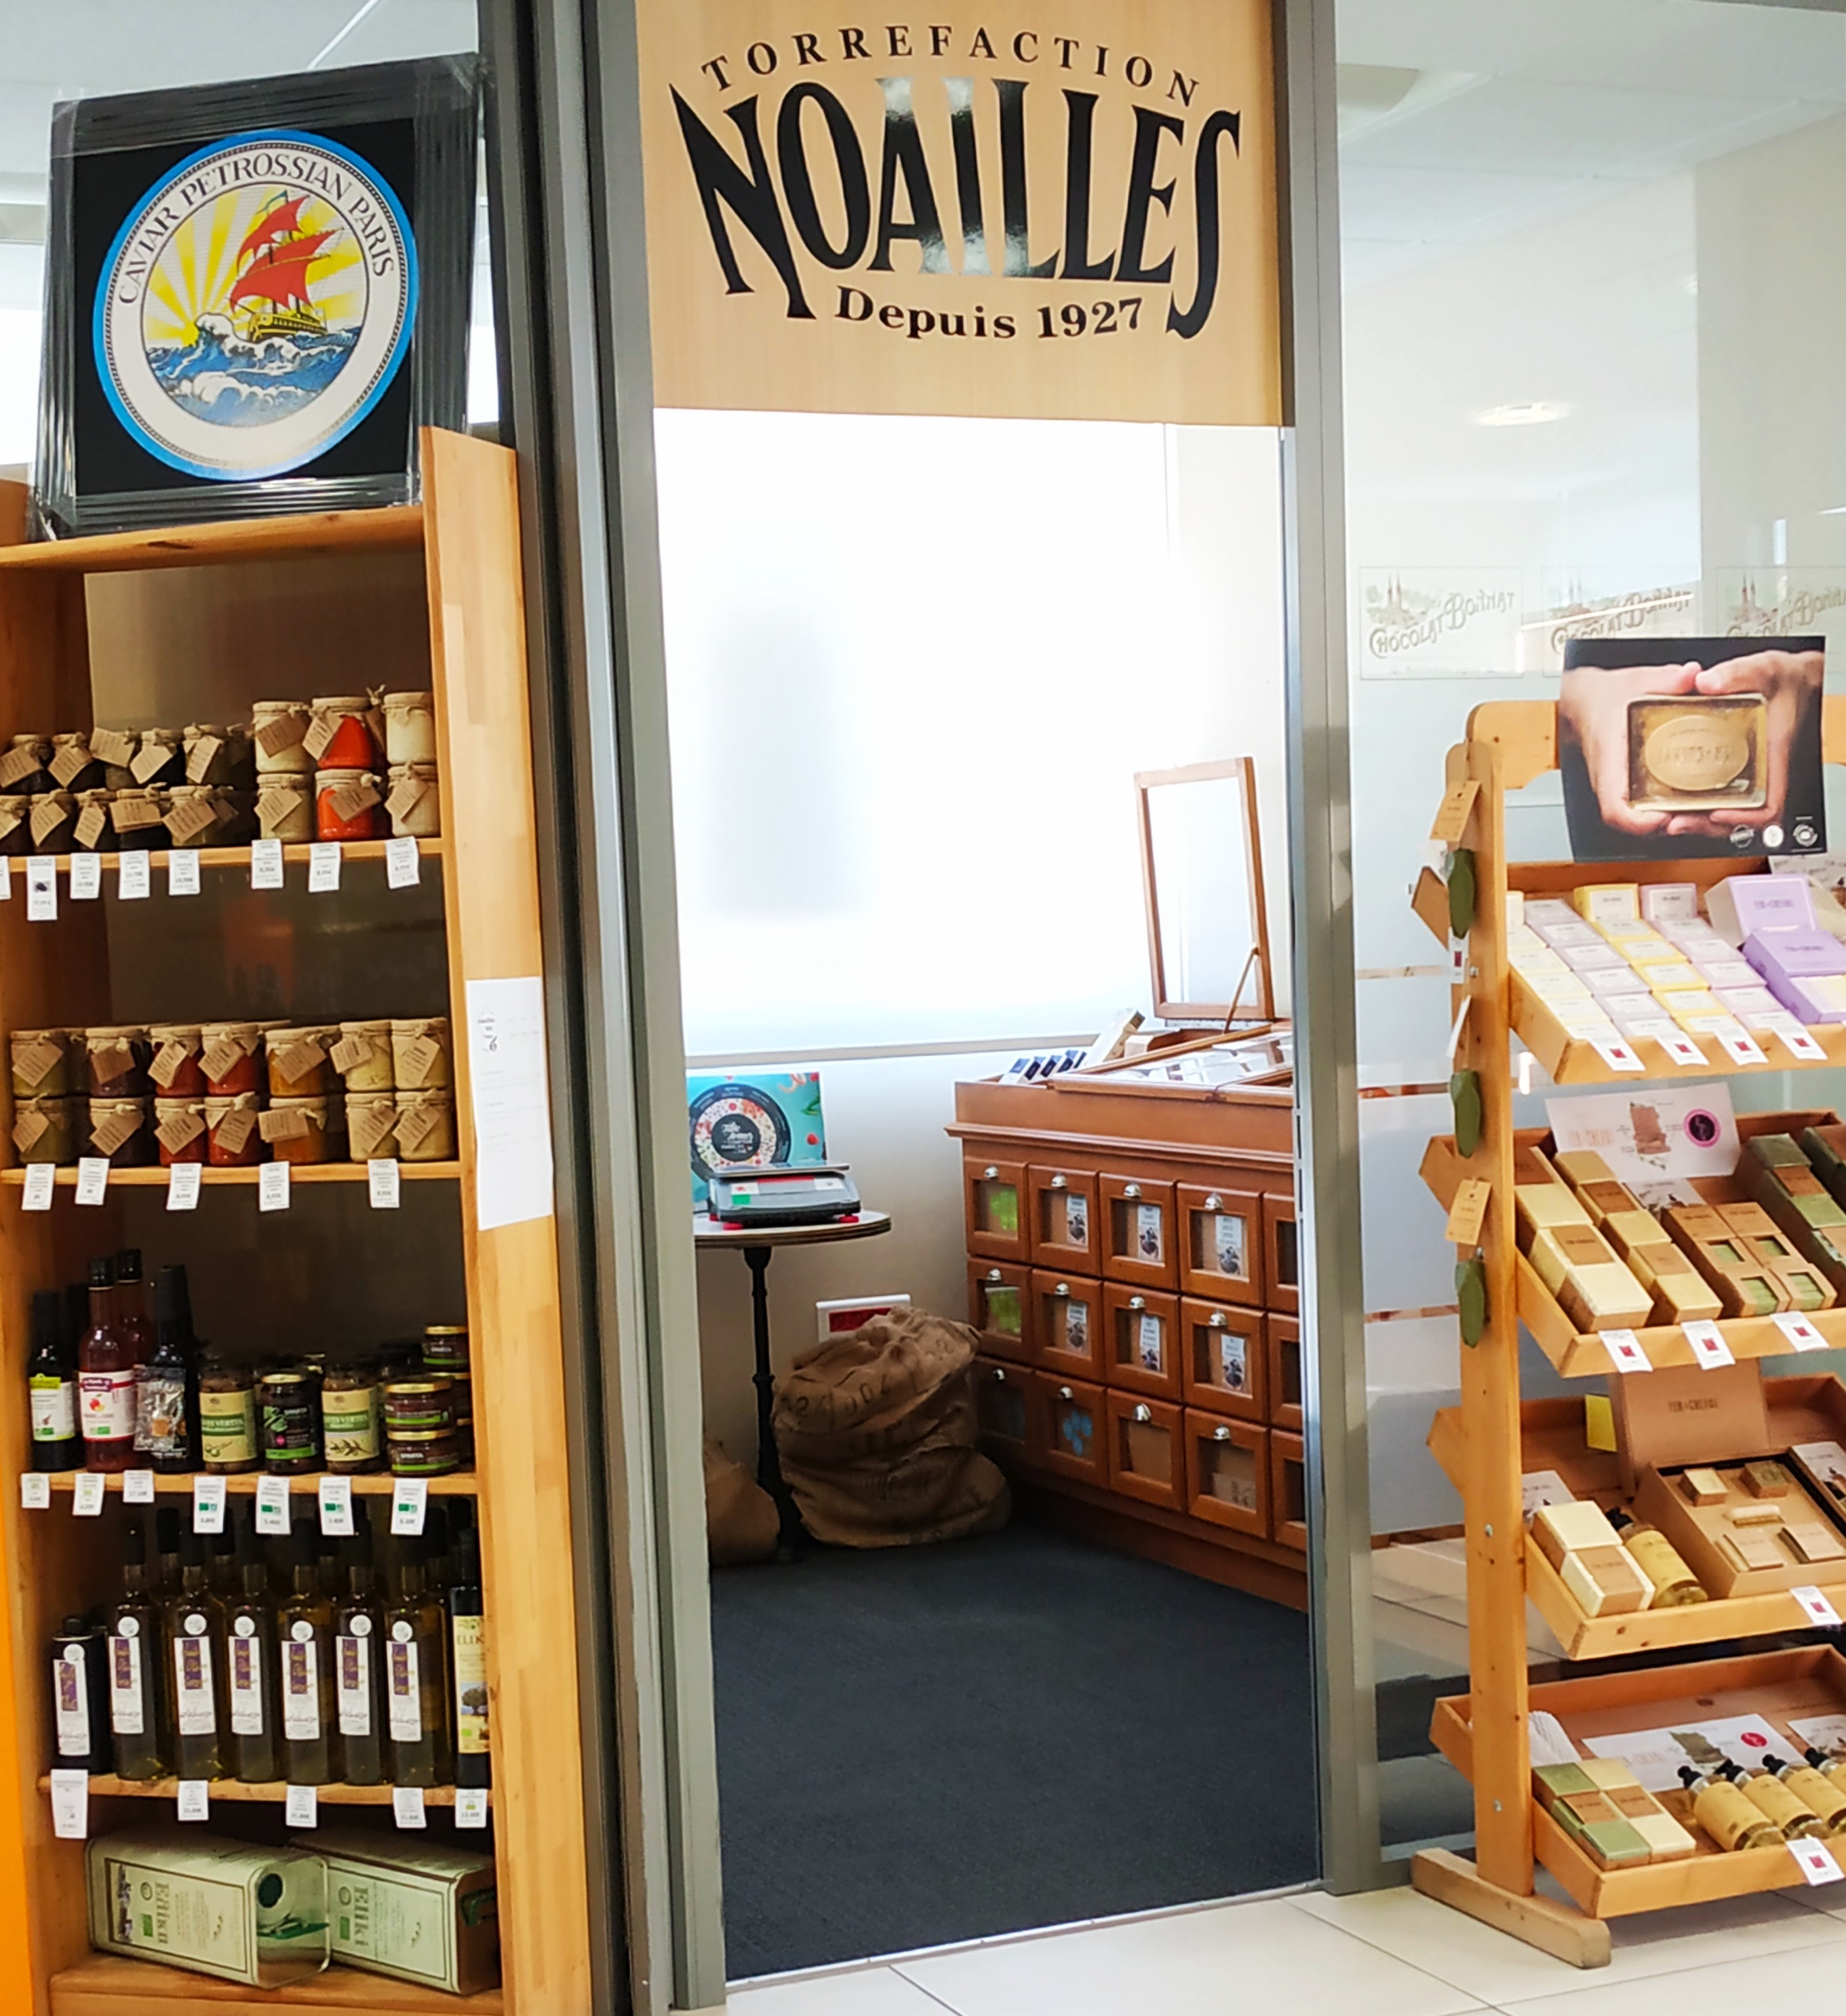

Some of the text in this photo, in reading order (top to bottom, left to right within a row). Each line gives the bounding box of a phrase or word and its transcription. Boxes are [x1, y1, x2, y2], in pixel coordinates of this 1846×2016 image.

[701, 24, 1200, 107] TORREFACTION
[118, 152, 395, 305] CAVIAR PETROSSIAN PARIS
[669, 76, 1241, 339] NOAILLES
[835, 284, 1143, 341] Depuis 1927
